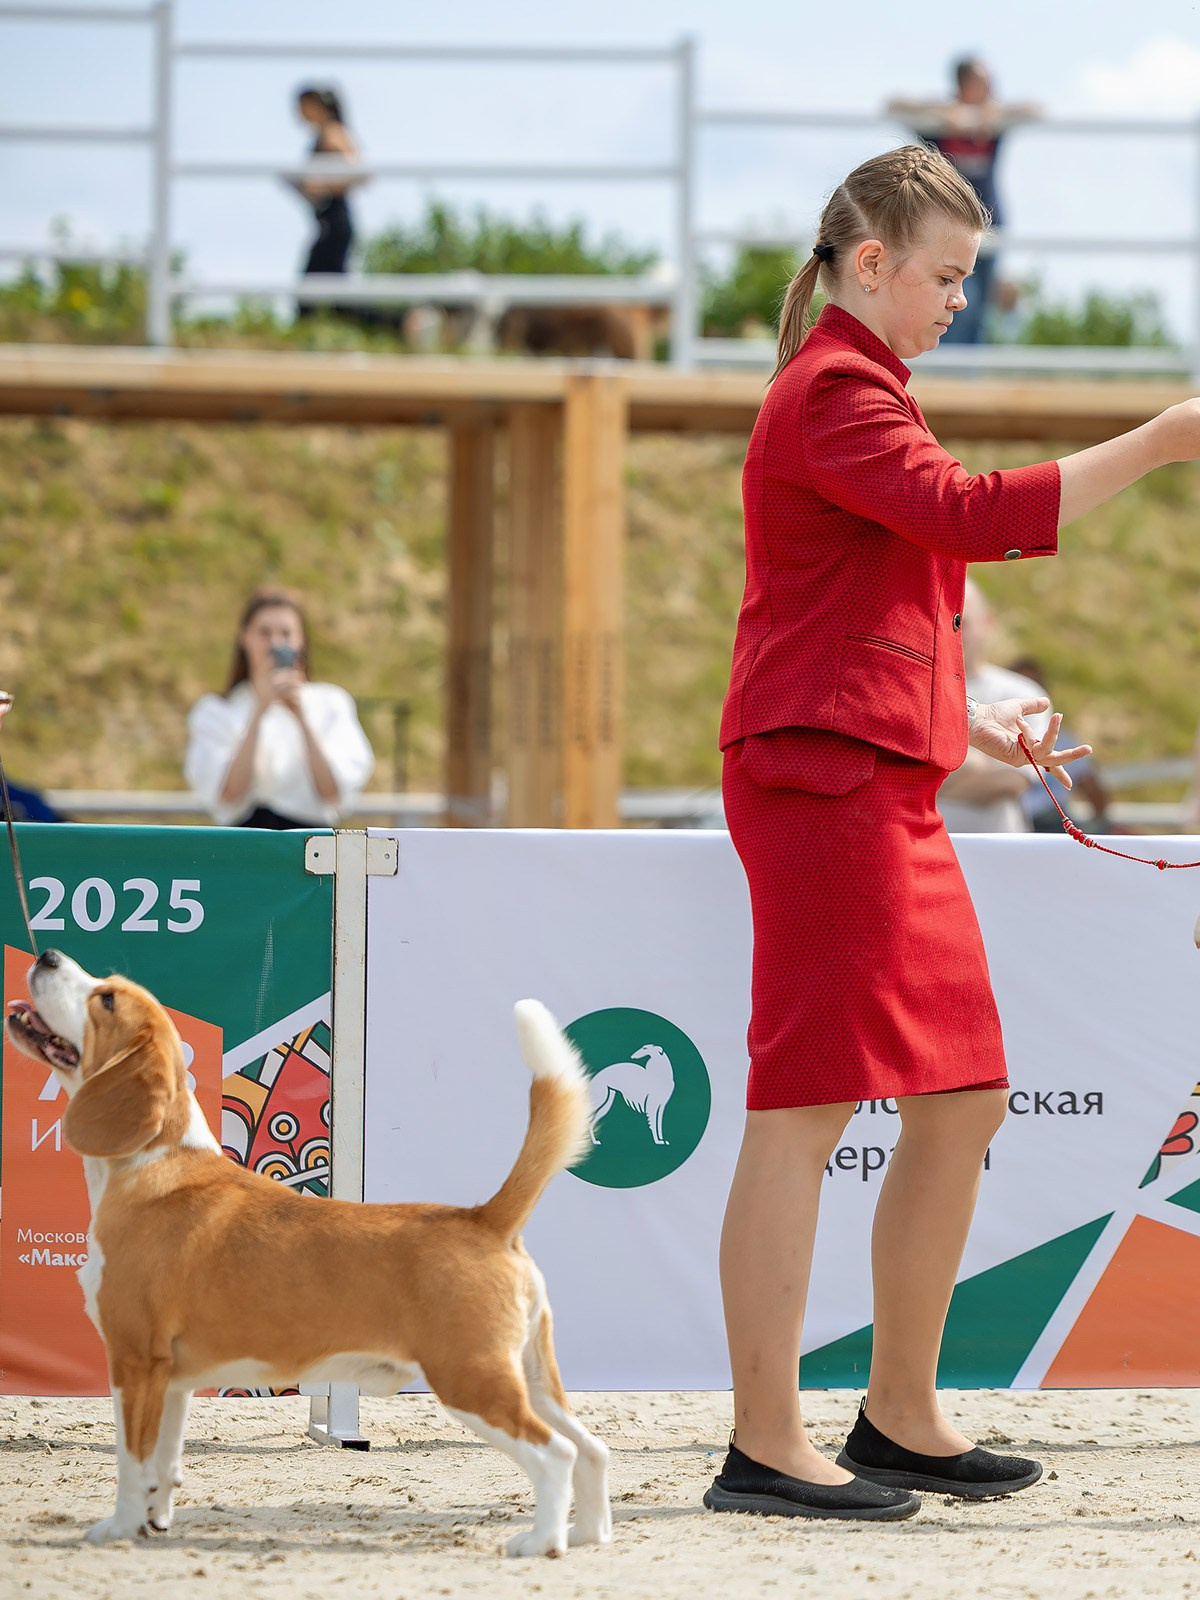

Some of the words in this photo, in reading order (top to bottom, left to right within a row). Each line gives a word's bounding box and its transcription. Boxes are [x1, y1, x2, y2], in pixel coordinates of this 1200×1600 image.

[28, 876, 205, 933] 2025
[17, 1228, 91, 1244] Москов
[18, 1248, 90, 1267] «Макс
